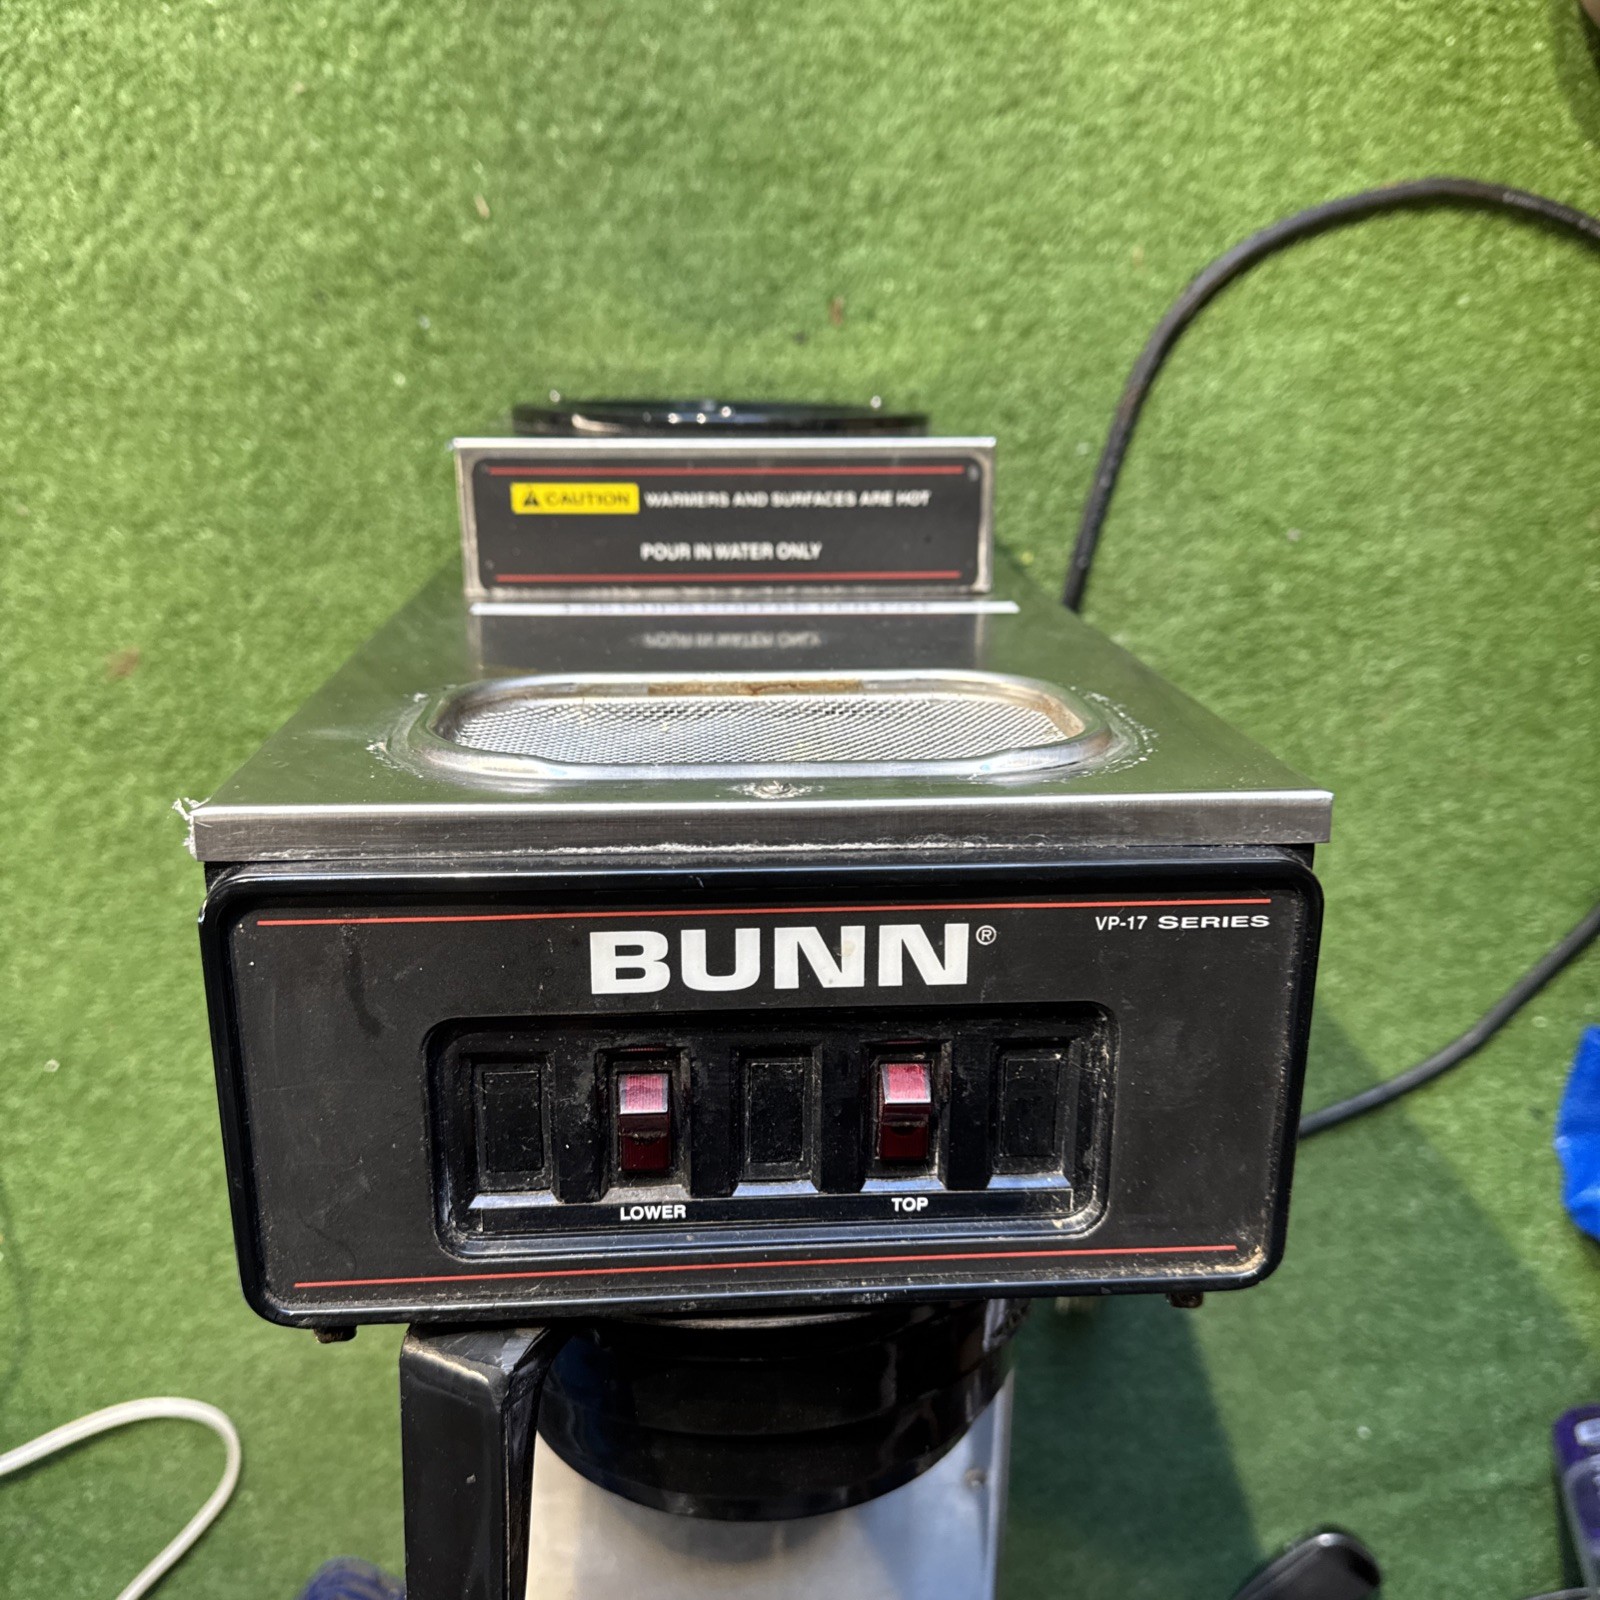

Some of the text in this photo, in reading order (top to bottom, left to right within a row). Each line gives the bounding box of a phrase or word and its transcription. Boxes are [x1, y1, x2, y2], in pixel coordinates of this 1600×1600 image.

[544, 489, 932, 508] CAUTION WARMERS AND SURFACES ARE HOT
[640, 541, 823, 561] POUR IN WATER ONLY
[1095, 914, 1270, 931] VP-17 SERIES
[619, 1204, 687, 1221] LOWER
[891, 1197, 929, 1212] TOP
